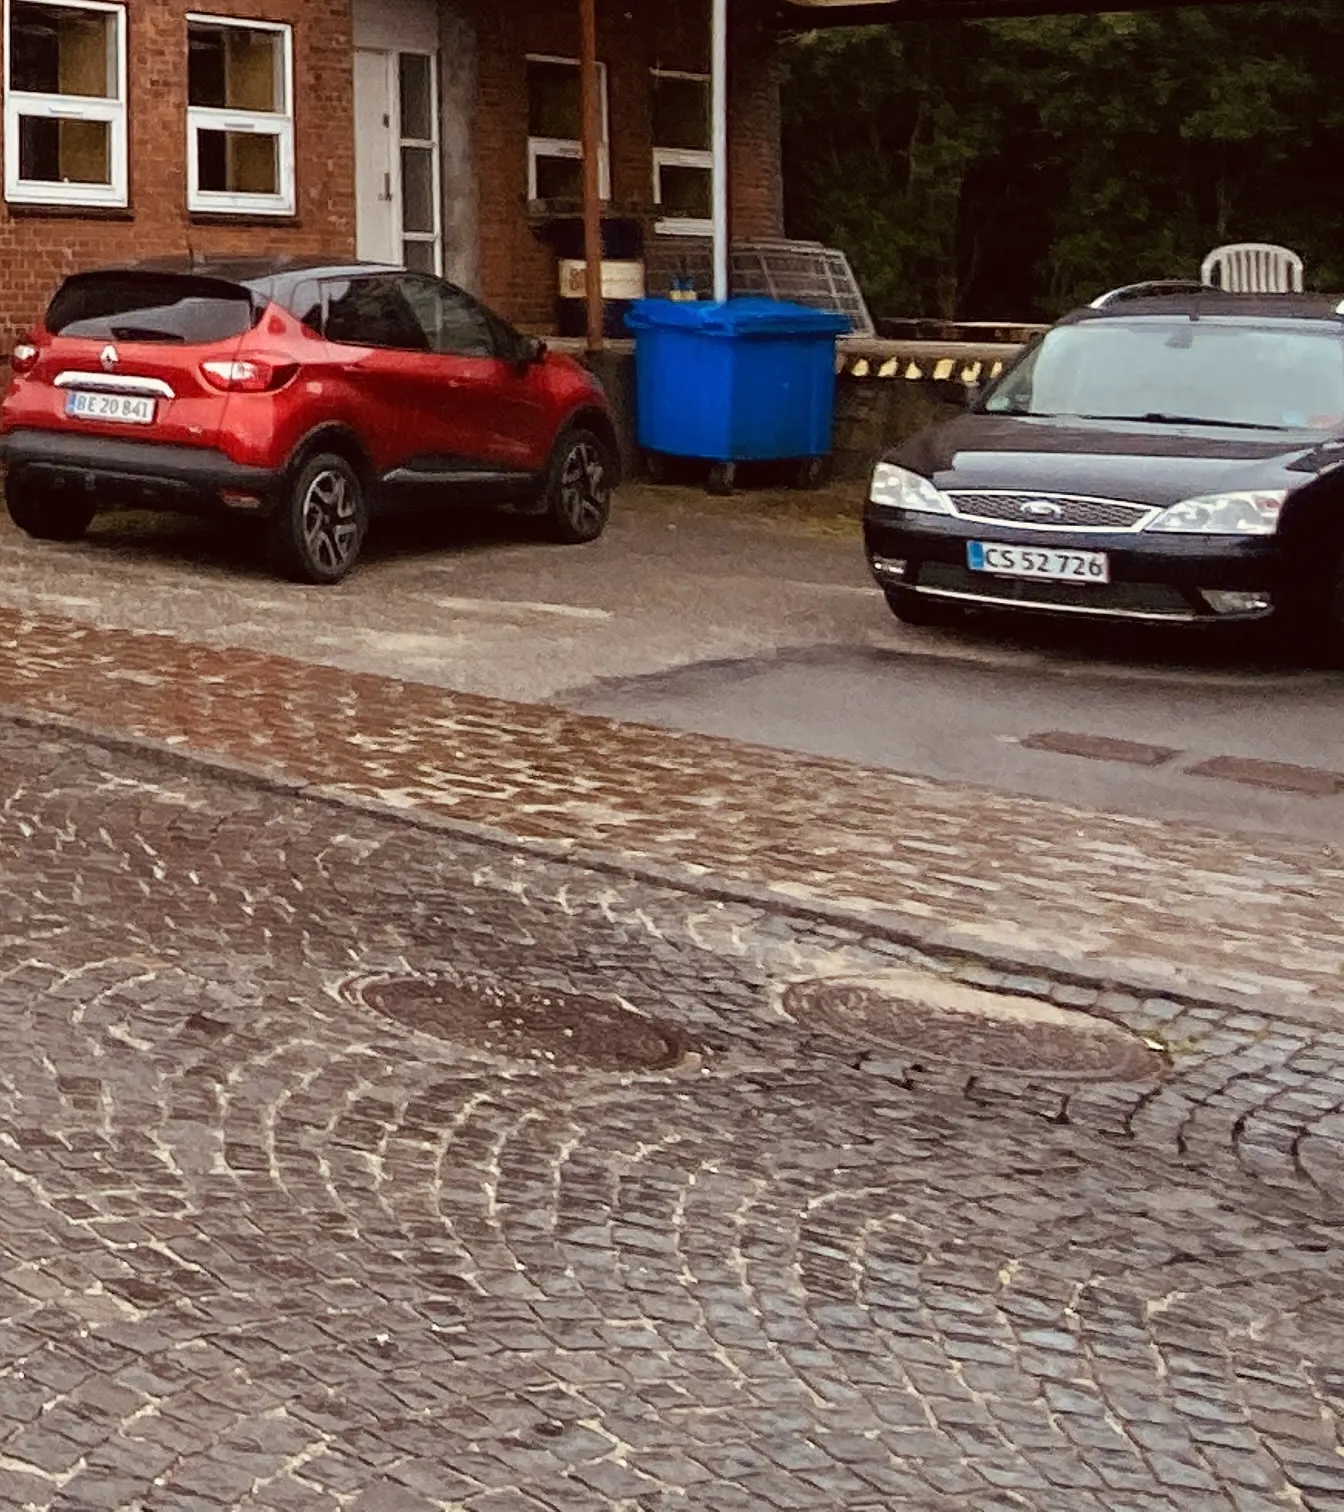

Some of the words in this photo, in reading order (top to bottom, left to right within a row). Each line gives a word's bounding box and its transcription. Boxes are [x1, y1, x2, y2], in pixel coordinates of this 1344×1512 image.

[76, 395, 97, 412] BE
[99, 397, 119, 414] 20
[122, 399, 148, 418] 841
[986, 548, 1015, 569] CS
[1021, 551, 1049, 572] 52
[1055, 555, 1102, 576] 726
